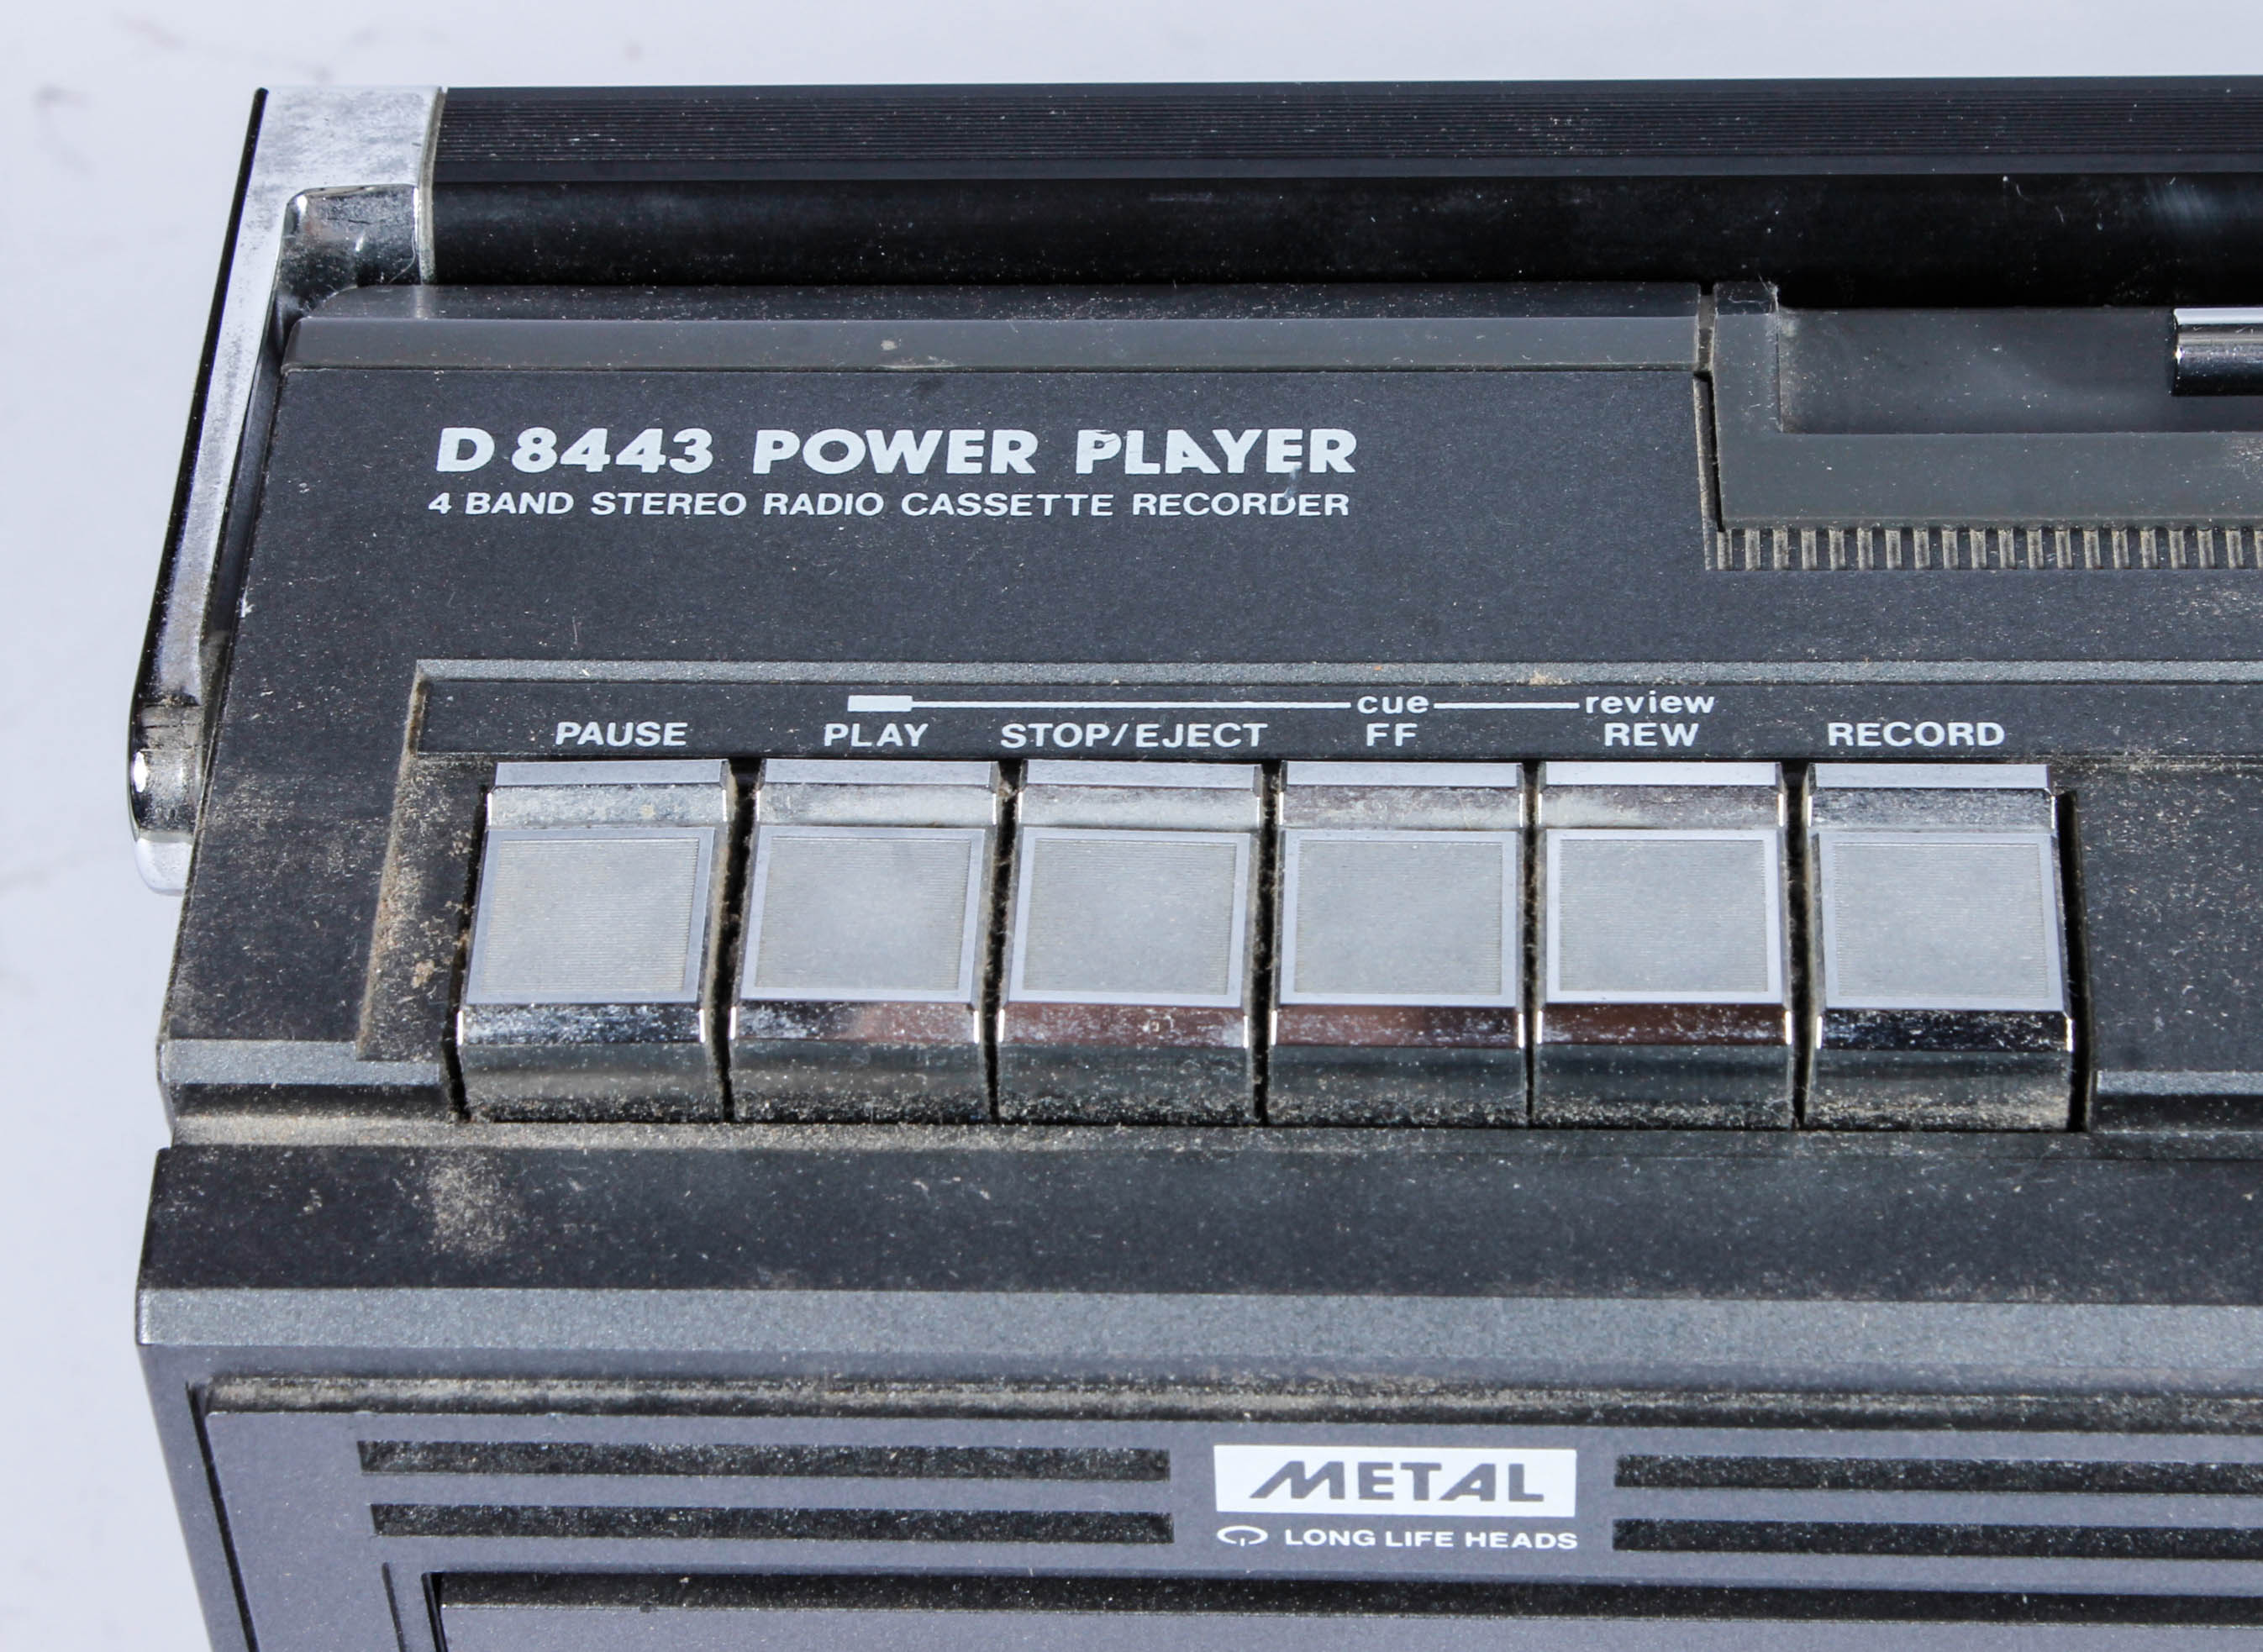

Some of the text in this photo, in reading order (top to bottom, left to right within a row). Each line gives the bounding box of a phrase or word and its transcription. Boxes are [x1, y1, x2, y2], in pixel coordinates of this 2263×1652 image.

[435, 427, 1358, 476] D 8443 POWER PLAYER
[428, 492, 1350, 517] 4 BAND STEREO RADIO CASSETTE RECORDER
[1356, 695, 1429, 715] cue
[1585, 690, 1715, 715] review
[555, 721, 688, 747] PAUSE
[823, 723, 929, 748] PLAY
[1000, 722, 1269, 749] STOP/EJECT
[1366, 722, 1419, 747] FF
[1604, 722, 1699, 747] REW
[1827, 721, 2006, 747] RECORD
[1249, 1460, 1545, 1503] METAL
[1283, 1528, 1579, 1550] LONG LIFE HEADS
